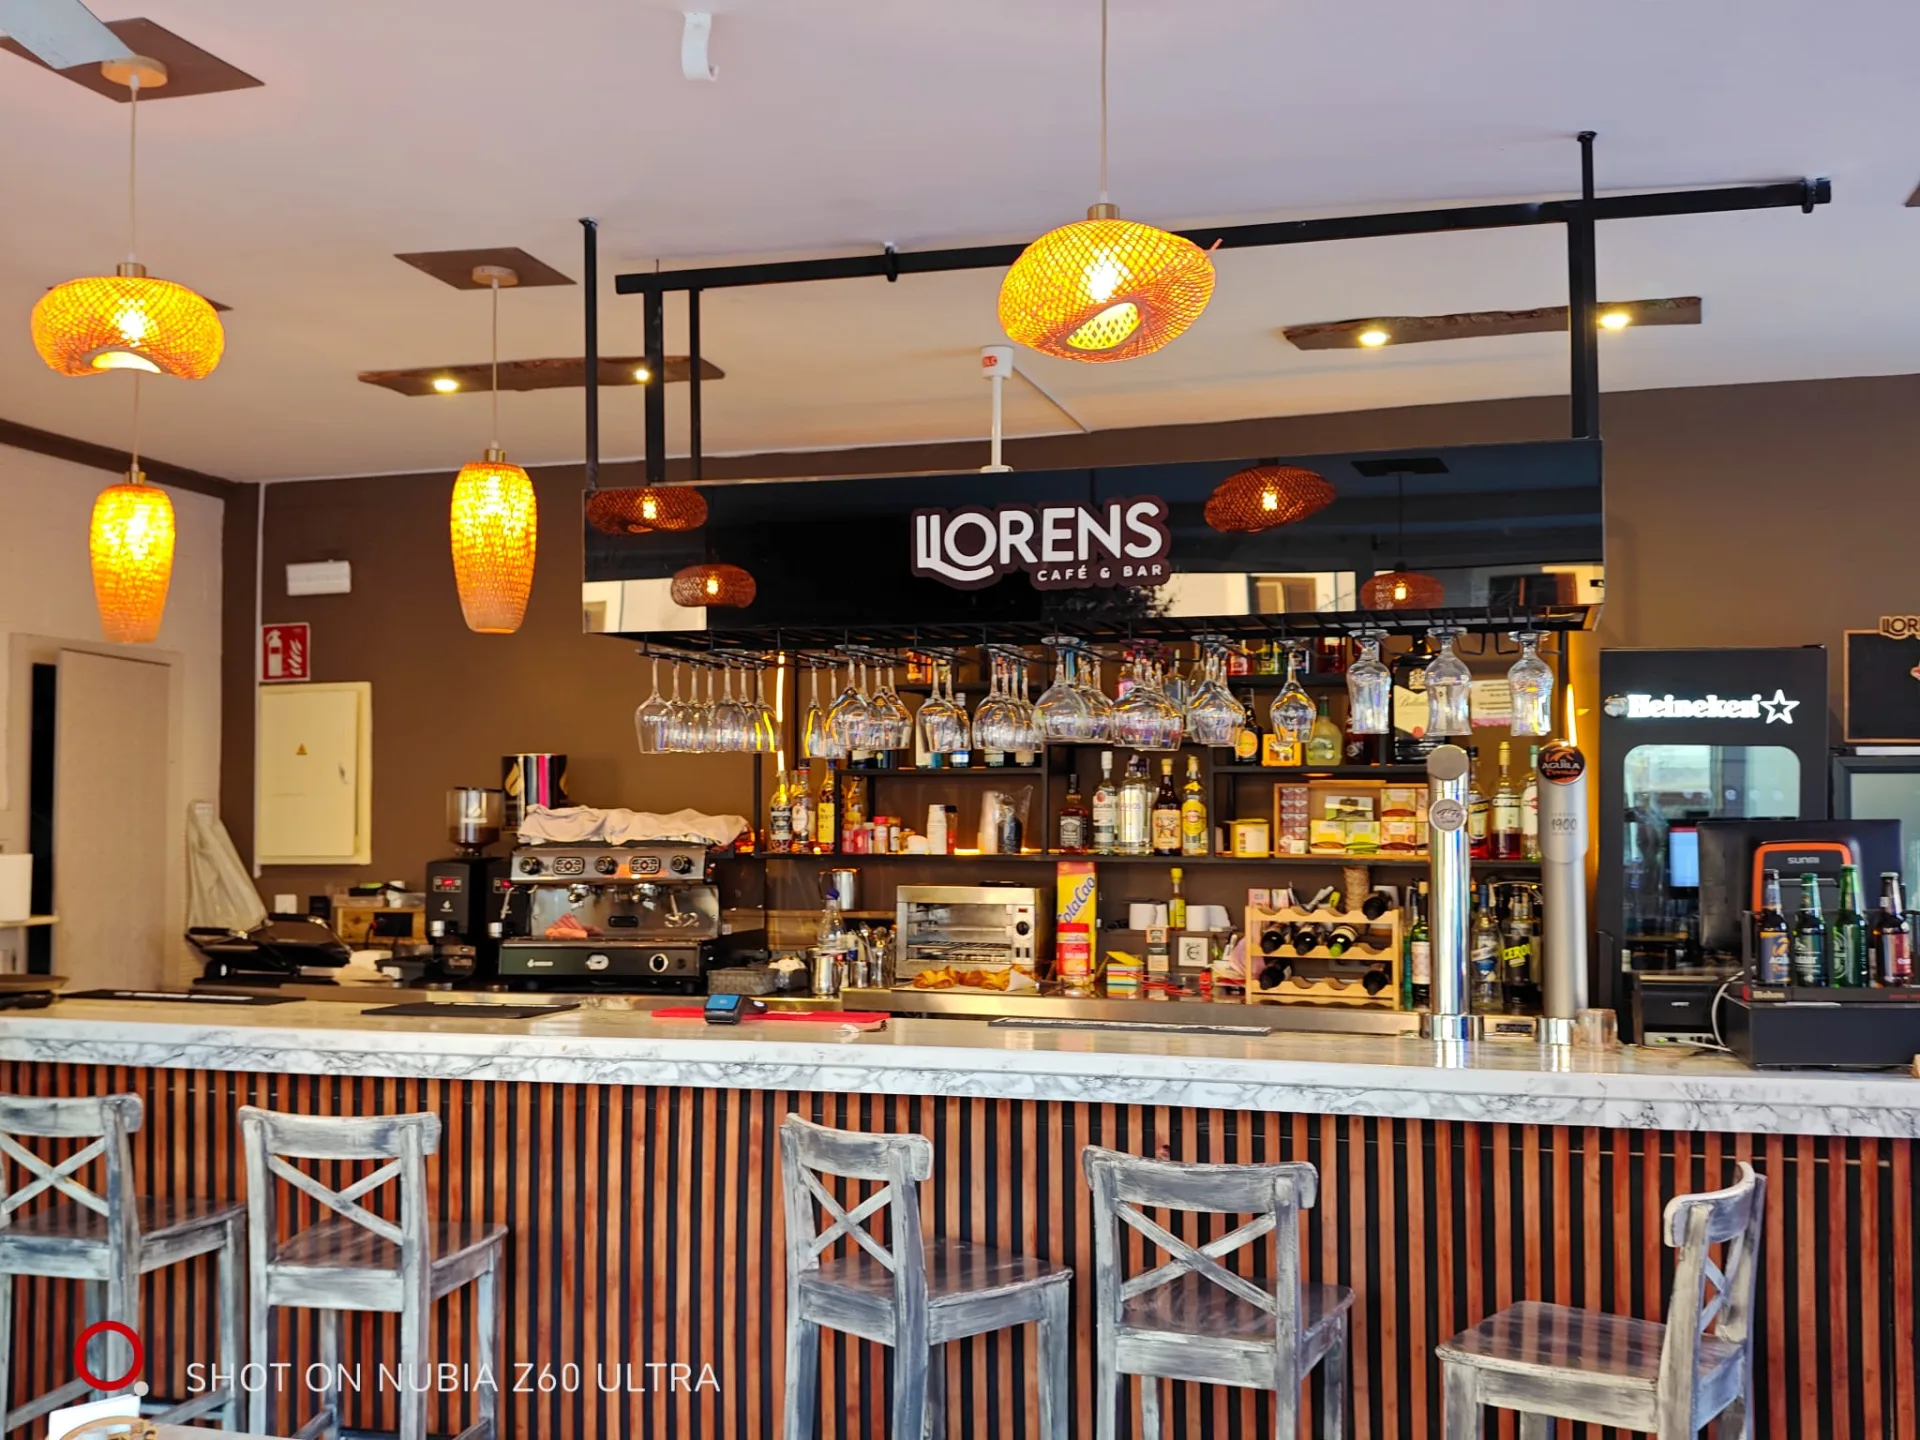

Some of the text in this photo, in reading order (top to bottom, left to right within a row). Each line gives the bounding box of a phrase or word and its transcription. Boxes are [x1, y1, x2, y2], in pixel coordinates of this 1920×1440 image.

[917, 502, 1162, 581] LLORENS
[1037, 564, 1163, 581] CAFÉ & BAR
[1882, 618, 1920, 637] LLOR
[1627, 694, 1761, 719] Heineken
[1551, 818, 1578, 831] 1900
